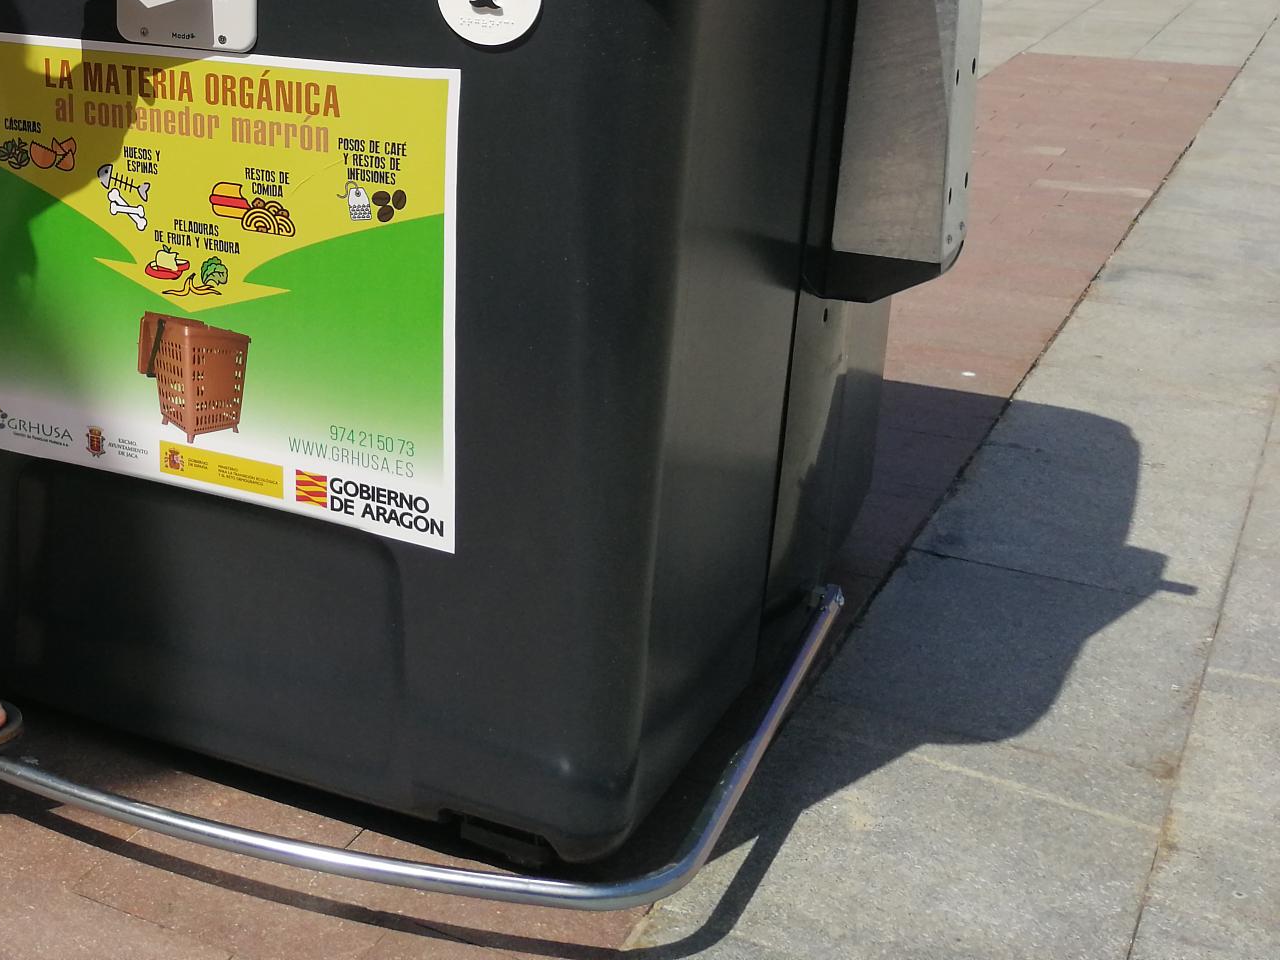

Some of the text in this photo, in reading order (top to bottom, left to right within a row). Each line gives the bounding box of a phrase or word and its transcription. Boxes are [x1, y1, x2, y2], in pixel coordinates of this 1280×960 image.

[44, 58, 341, 118] LA MATERIA ORGÁNICA
[4, 117, 41, 134] CÁSCARAS
[55, 93, 329, 153] al contenedor marrón
[123, 146, 161, 162] HUESOS Y
[338, 137, 407, 157] POSOS DE CAFÉ
[127, 160, 158, 175] ESPINAS
[343, 152, 401, 171] Y RESTOS DE
[244, 167, 290, 185] RESTOS DE
[347, 167, 396, 185] INFUSIONES
[251, 182, 284, 198] COMIDA
[173, 219, 219, 237] PELADURAS
[154, 230, 241, 255] DE FRUTA Y VERDURA
[7, 418, 73, 441] GRHUSA
[288, 435, 414, 478] WWW.GRHUSA.ES
[329, 477, 430, 514] GOBIERNO
[330, 495, 445, 538] DE ARAGON
